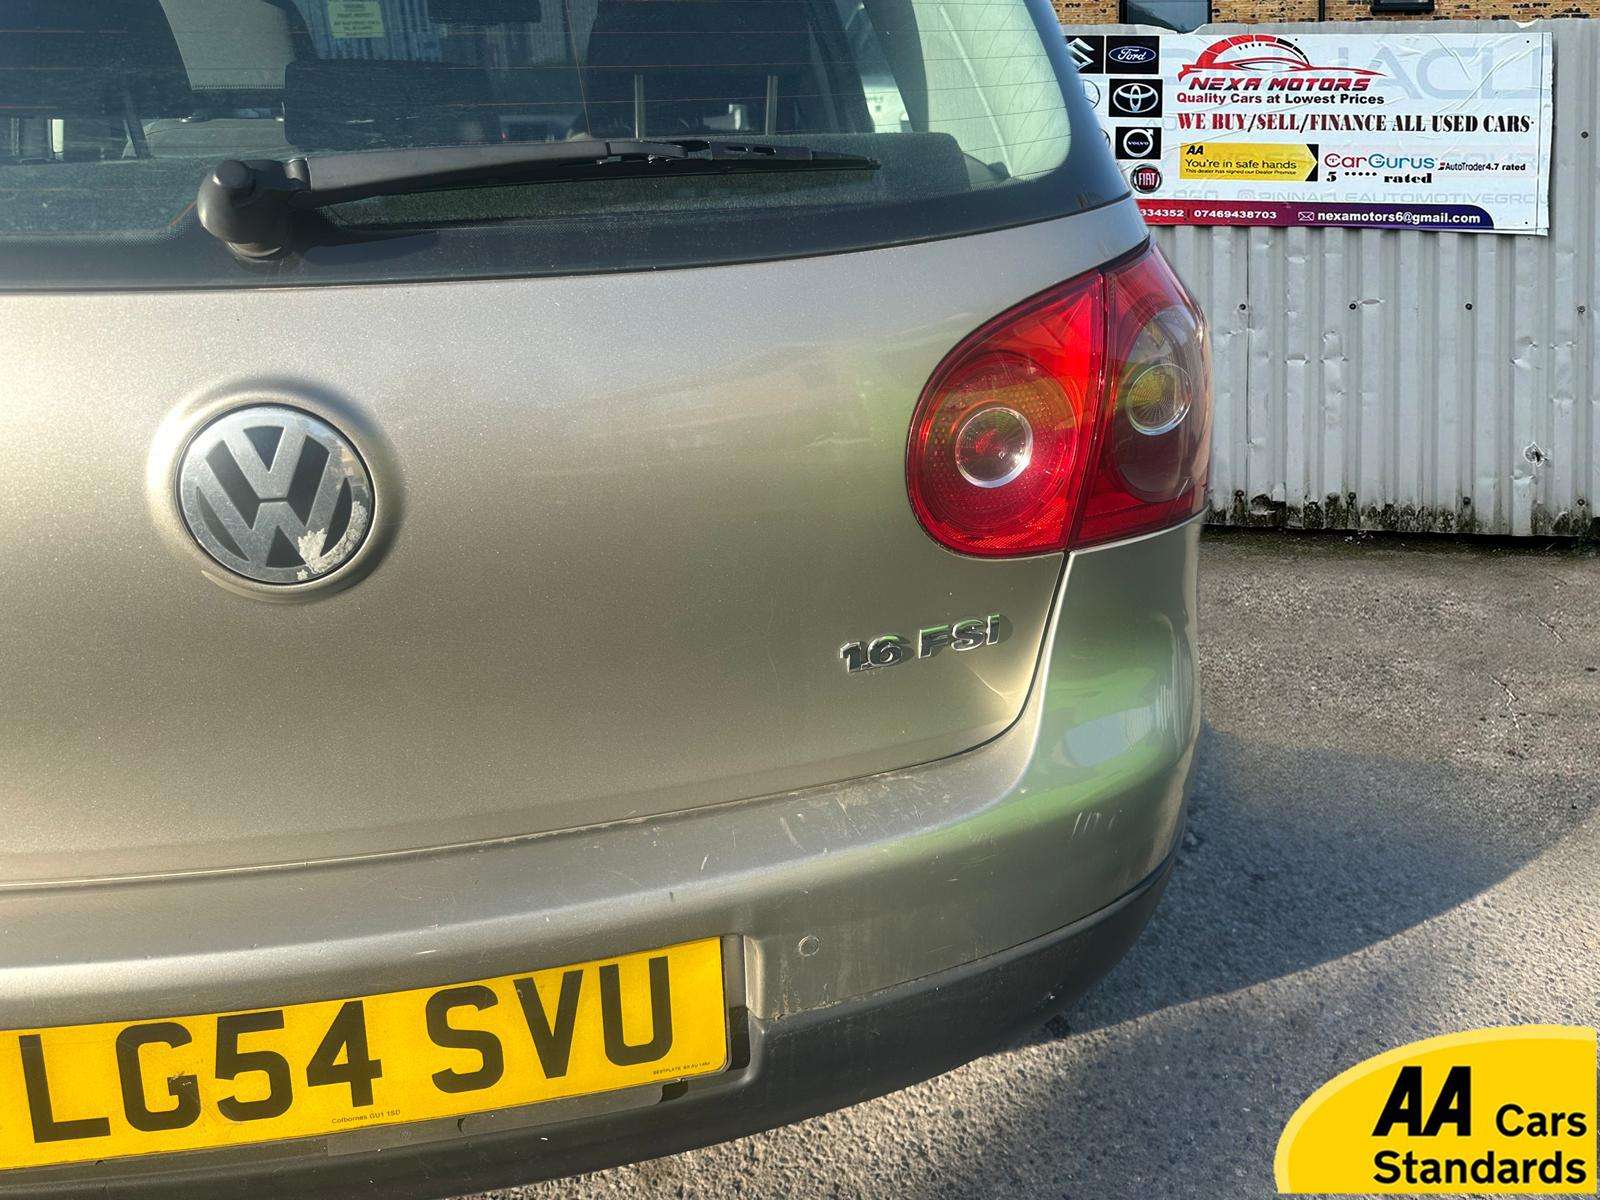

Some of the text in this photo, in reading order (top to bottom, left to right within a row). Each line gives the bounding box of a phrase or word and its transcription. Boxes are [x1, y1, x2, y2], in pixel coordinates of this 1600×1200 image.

[1117, 47, 1147, 61] Ford
[1189, 77, 1371, 91] NEXA MOTORS
[1177, 93, 1385, 105] Quality Cars at Lowest Prices
[1177, 112, 1206, 130] WE
[1211, 113, 1387, 133] BUY/SELL/FINANCE
[1391, 114, 1426, 131] ALL
[1431, 114, 1479, 132] USED
[1483, 114, 1531, 132] CARS
[1186, 145, 1204, 155] AA
[1185, 159, 1297, 169] You're in safe hands
[1324, 153, 1435, 169] CarGurus
[1502, 163, 1526, 171] rated
[1138, 172, 1156, 187] FIAT
[1326, 171, 1432, 184] 5 rated
[1194, 209, 1278, 220] 07469438703
[1317, 210, 1481, 225] nexamotors6@gmail.com
[918, 614, 1000, 659] FSI
[18, 956, 673, 1144] LG54 SVU
